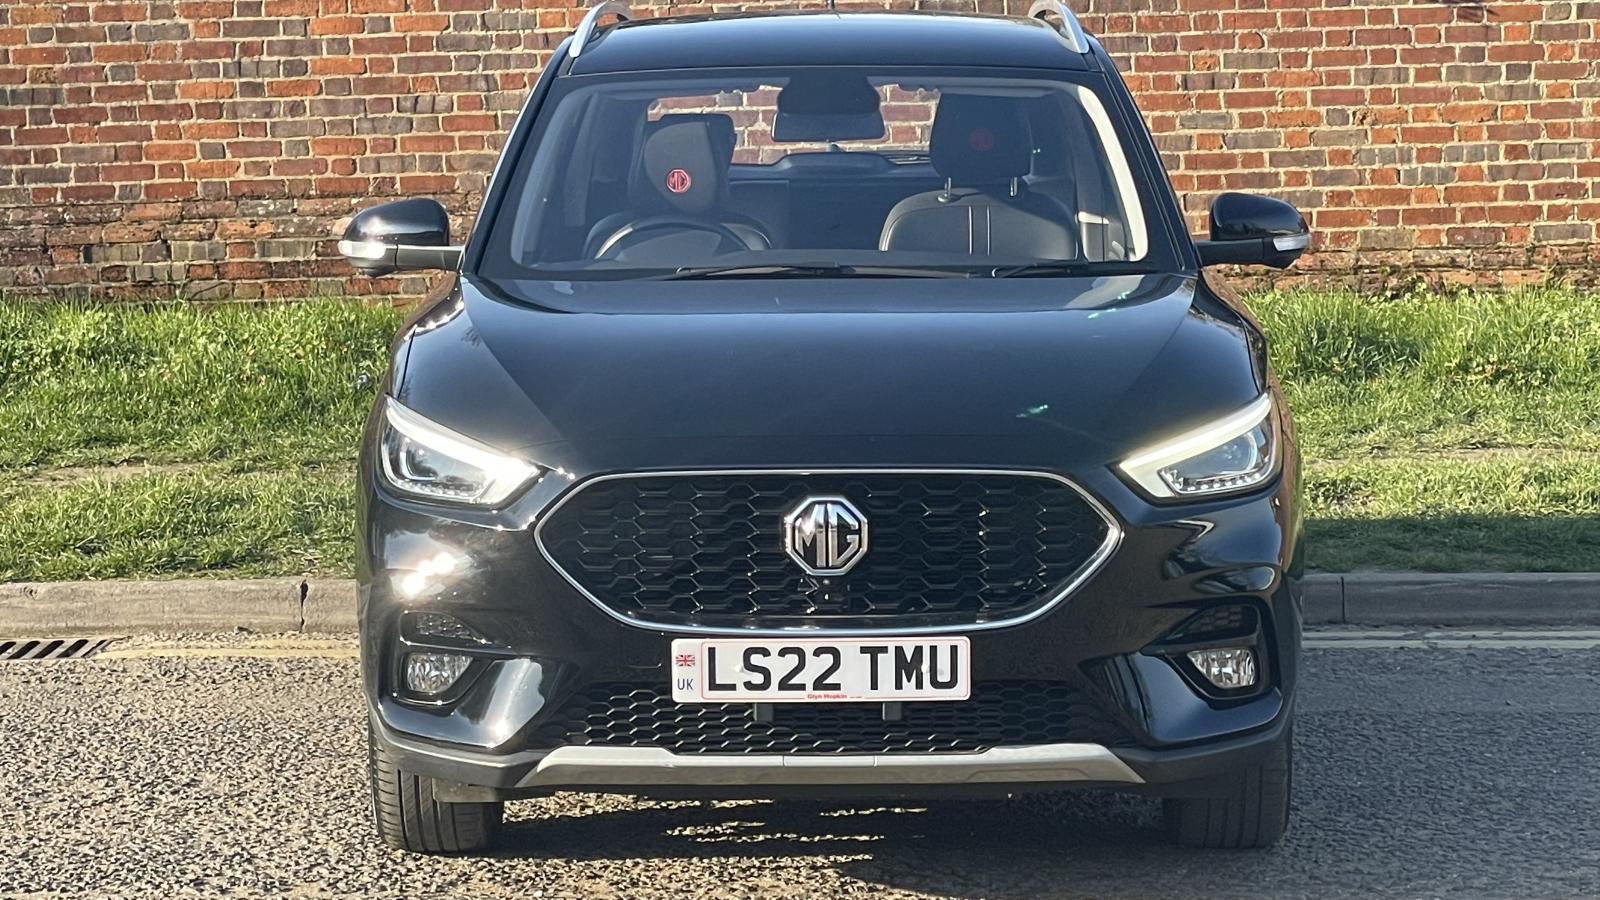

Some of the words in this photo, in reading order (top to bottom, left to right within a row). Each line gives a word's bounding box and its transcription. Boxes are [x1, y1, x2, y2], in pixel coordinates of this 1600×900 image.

[669, 171, 688, 190] MG
[795, 503, 859, 567] MG
[677, 678, 694, 691] UK
[707, 646, 842, 692] LS22
[859, 644, 959, 691] TMU
